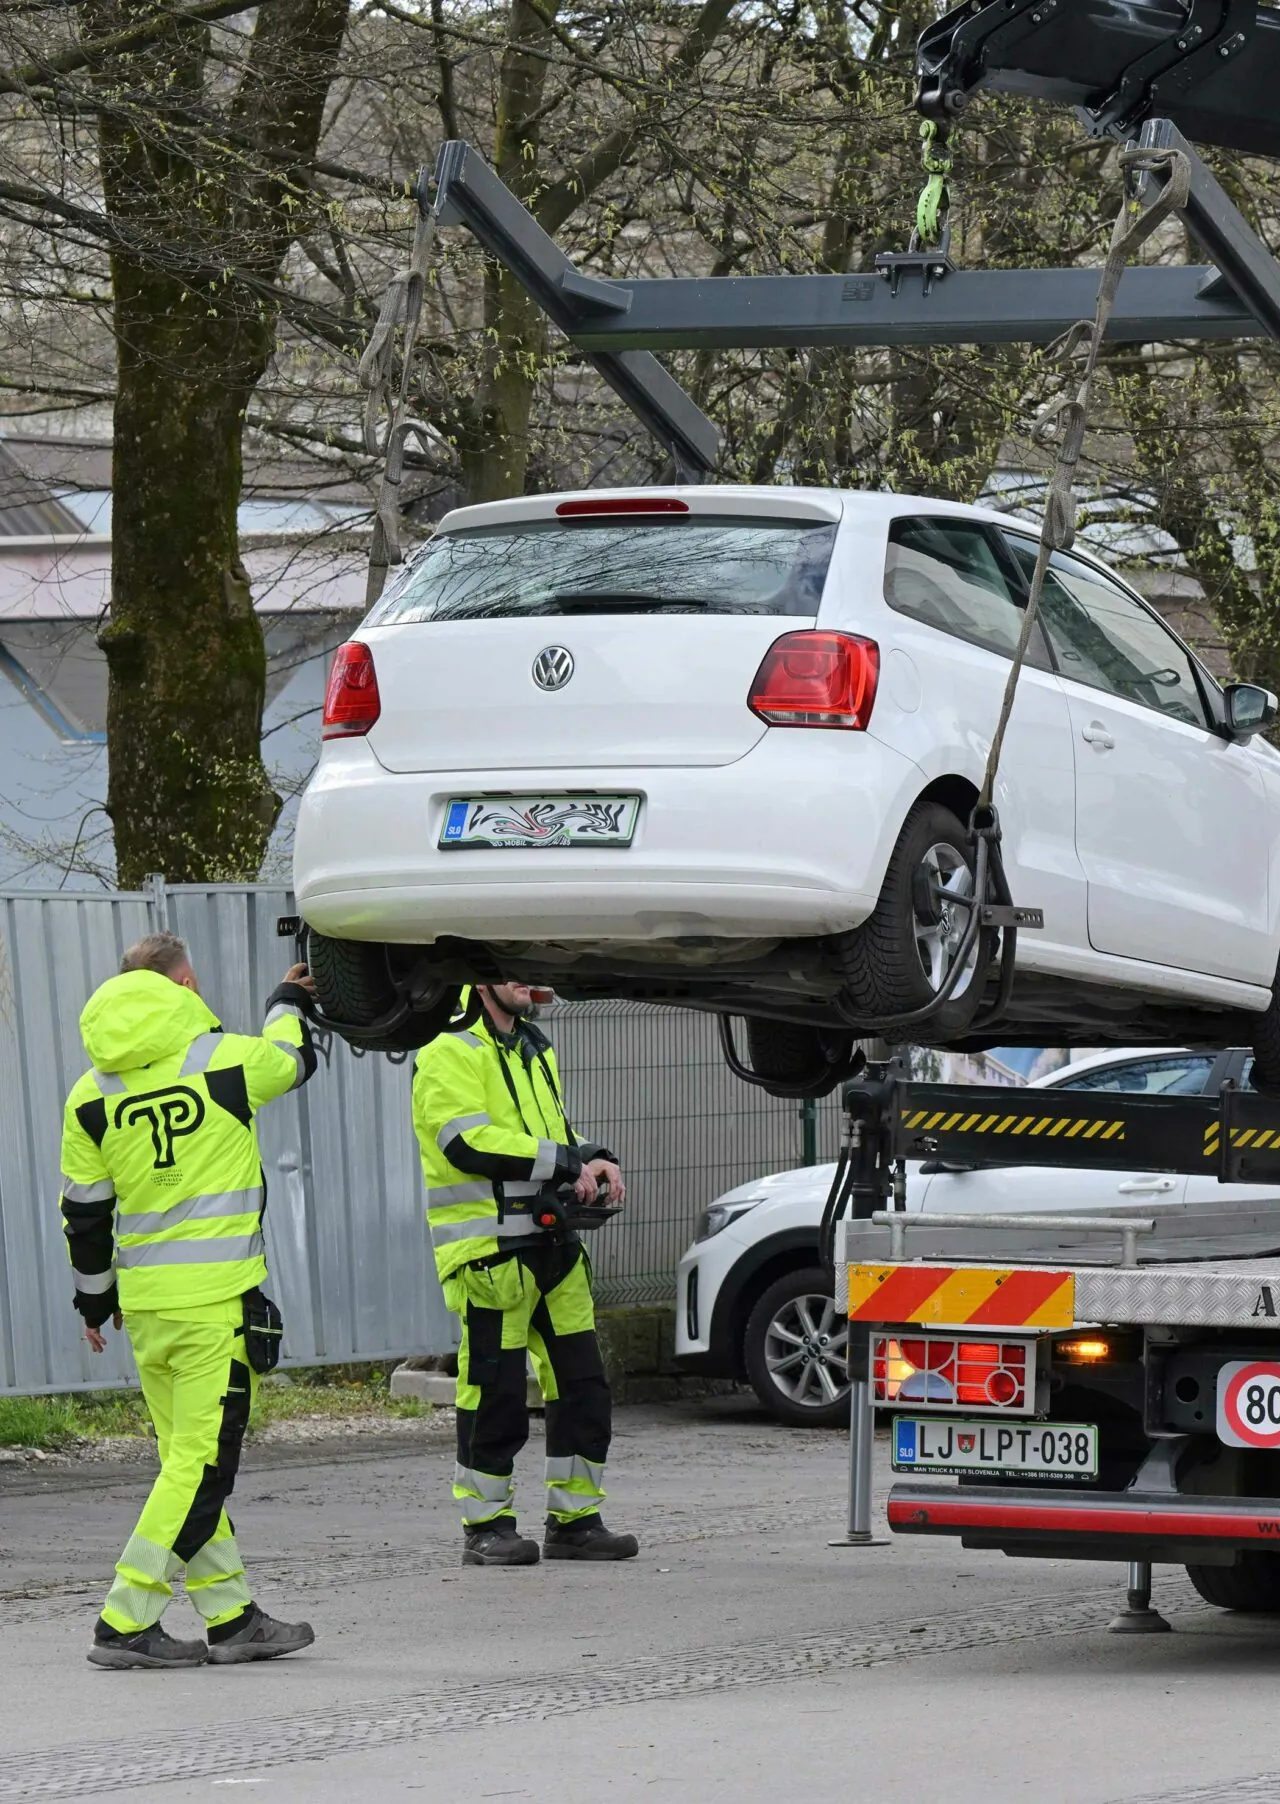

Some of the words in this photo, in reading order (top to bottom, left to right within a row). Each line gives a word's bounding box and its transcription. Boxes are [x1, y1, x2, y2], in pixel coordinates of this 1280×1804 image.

[448, 827, 461, 835] SLO
[919, 1425, 953, 1459] LJ
[979, 1428, 1089, 1466] LPT-038
[899, 1448, 913, 1458] SLO
